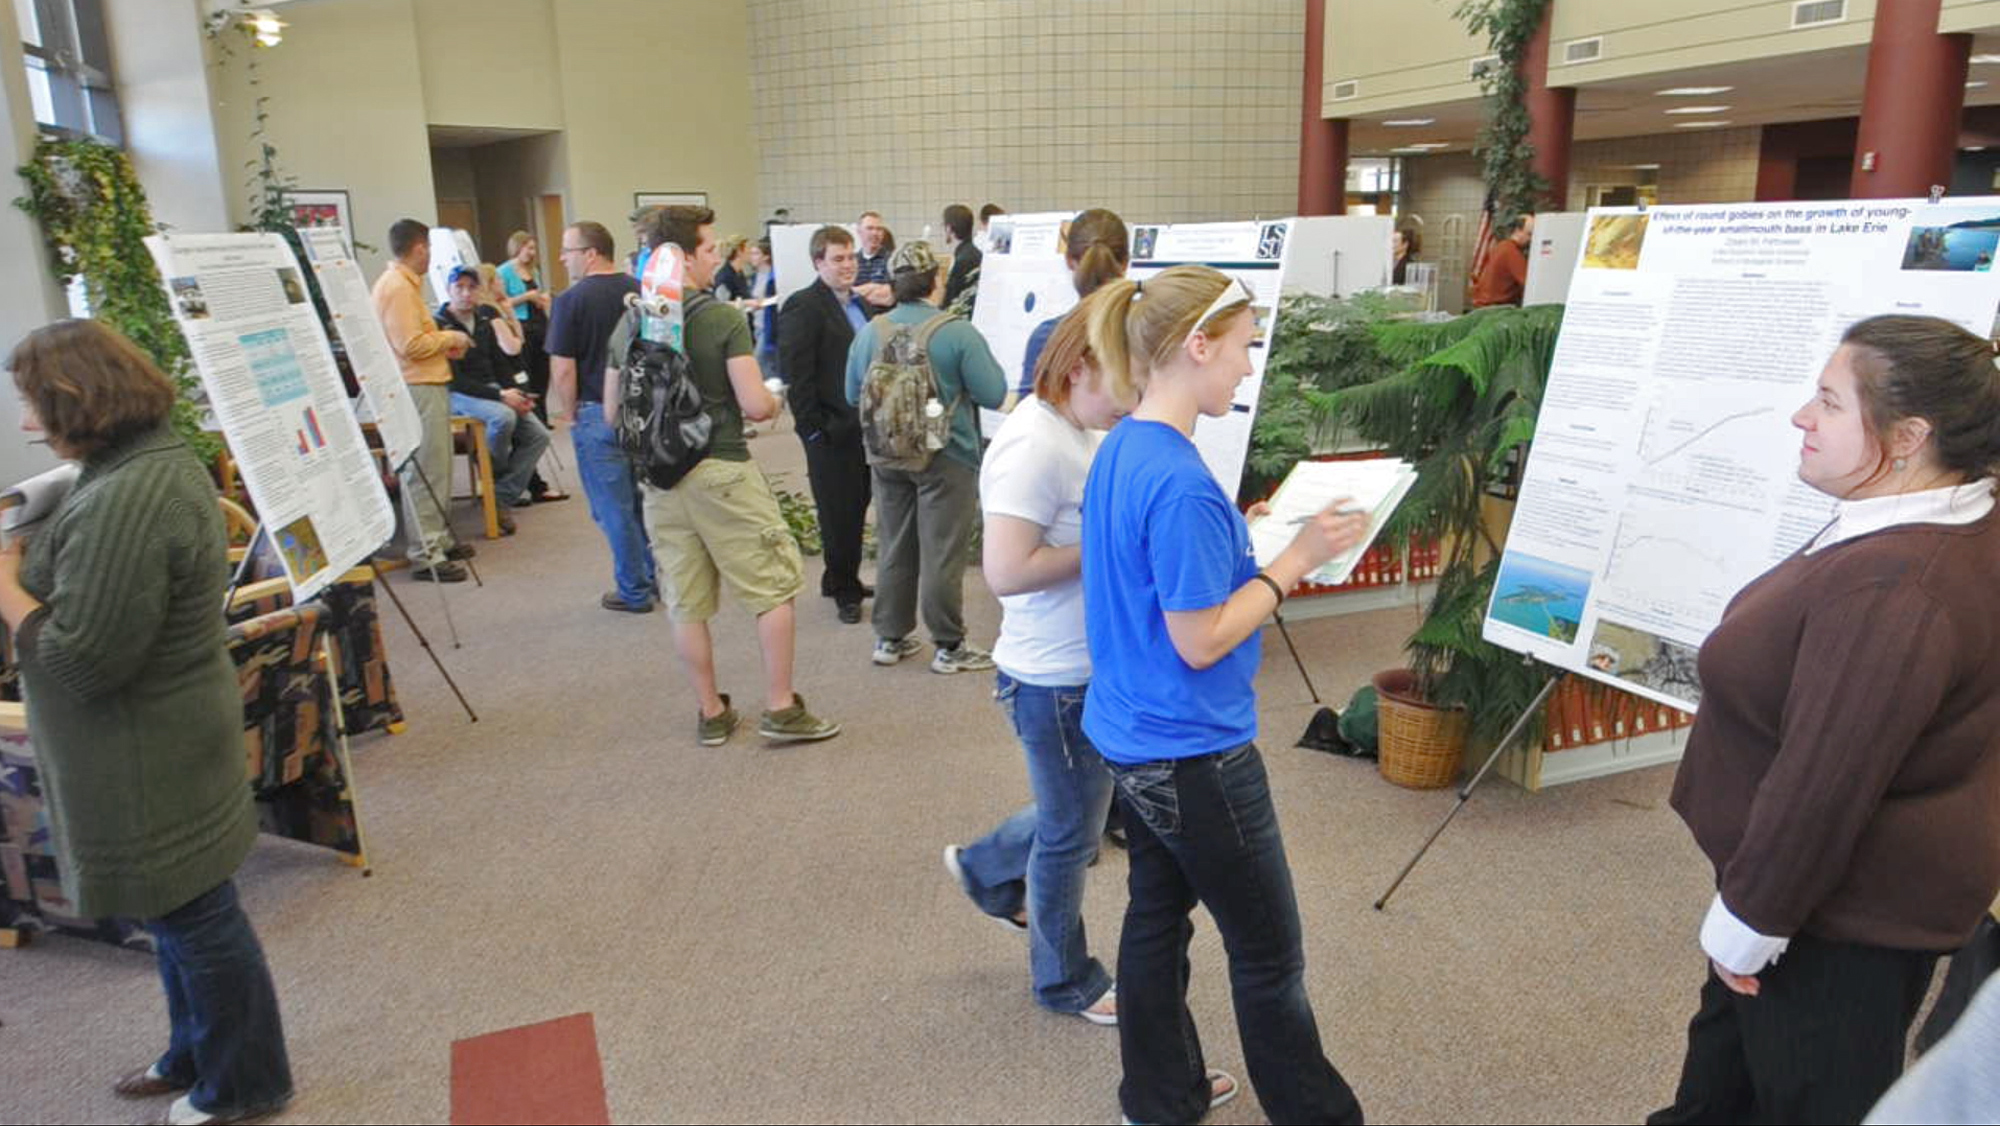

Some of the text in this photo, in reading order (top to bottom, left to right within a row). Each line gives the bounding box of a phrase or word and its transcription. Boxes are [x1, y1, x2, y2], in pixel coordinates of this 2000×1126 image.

[1653, 211, 1681, 220] Effect
[1695, 210, 1726, 219] round
[1728, 209, 1764, 222] gobies
[1766, 210, 1782, 219] on
[1784, 209, 1803, 218] the
[1805, 208, 1848, 221] growth
[1850, 206, 1865, 218] of
[1867, 206, 1913, 220] young-
[1720, 224, 1783, 233] smallmouth
[1785, 223, 1813, 234] bass
[1815, 222, 1827, 234] in
[1830, 222, 1860, 234] Lake
[1862, 221, 1888, 233] Erie
